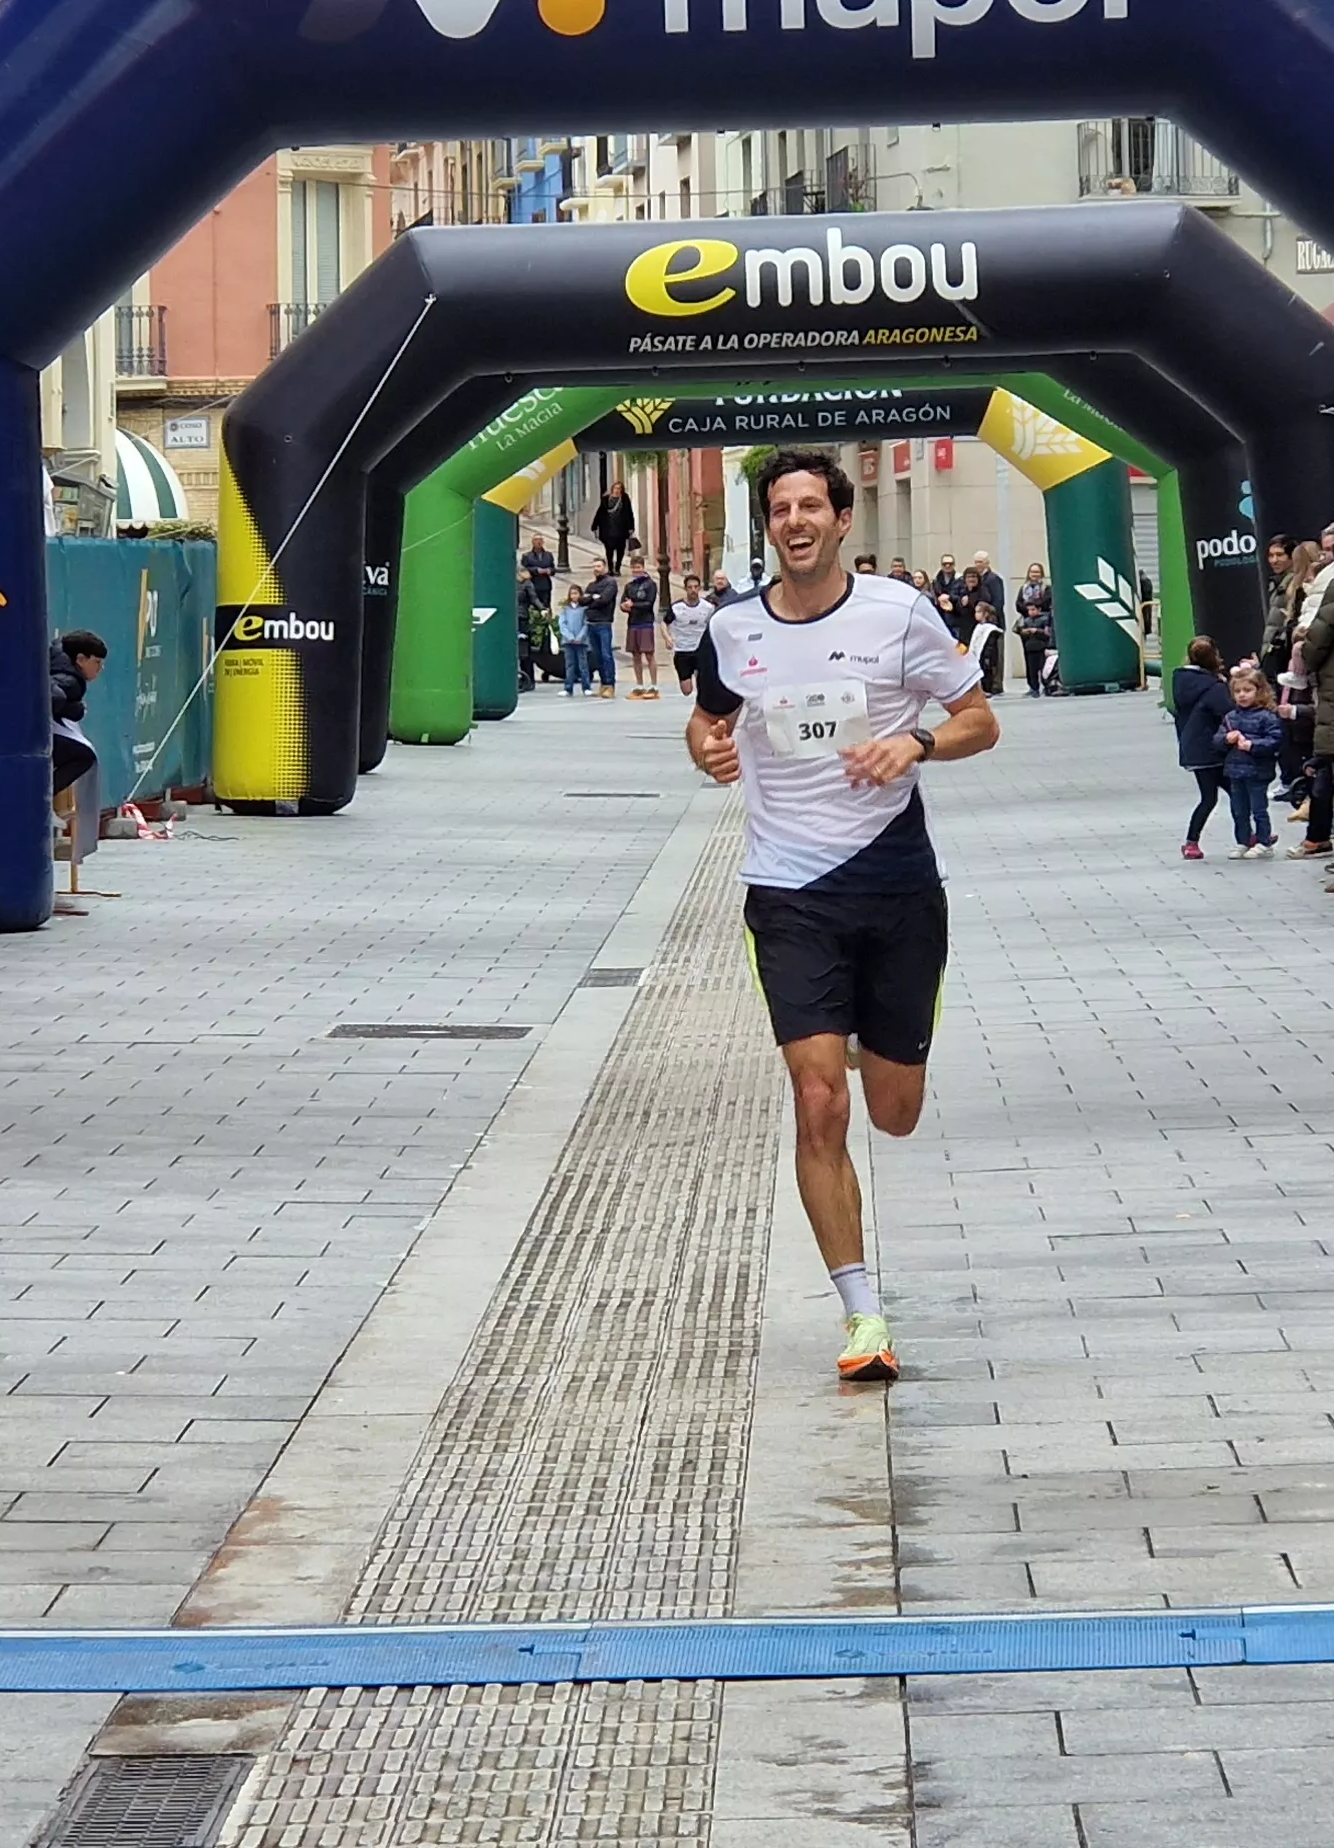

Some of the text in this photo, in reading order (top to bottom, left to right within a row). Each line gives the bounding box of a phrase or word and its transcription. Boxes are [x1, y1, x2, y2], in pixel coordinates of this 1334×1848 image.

[625, 227, 979, 317] embou
[629, 325, 979, 353] PÁSATE A LA OPERADORA ARAGONESA
[668, 404, 952, 434] CAJA RURAL DE ARAGÓN
[233, 612, 335, 641] embou
[798, 720, 837, 741] 307
